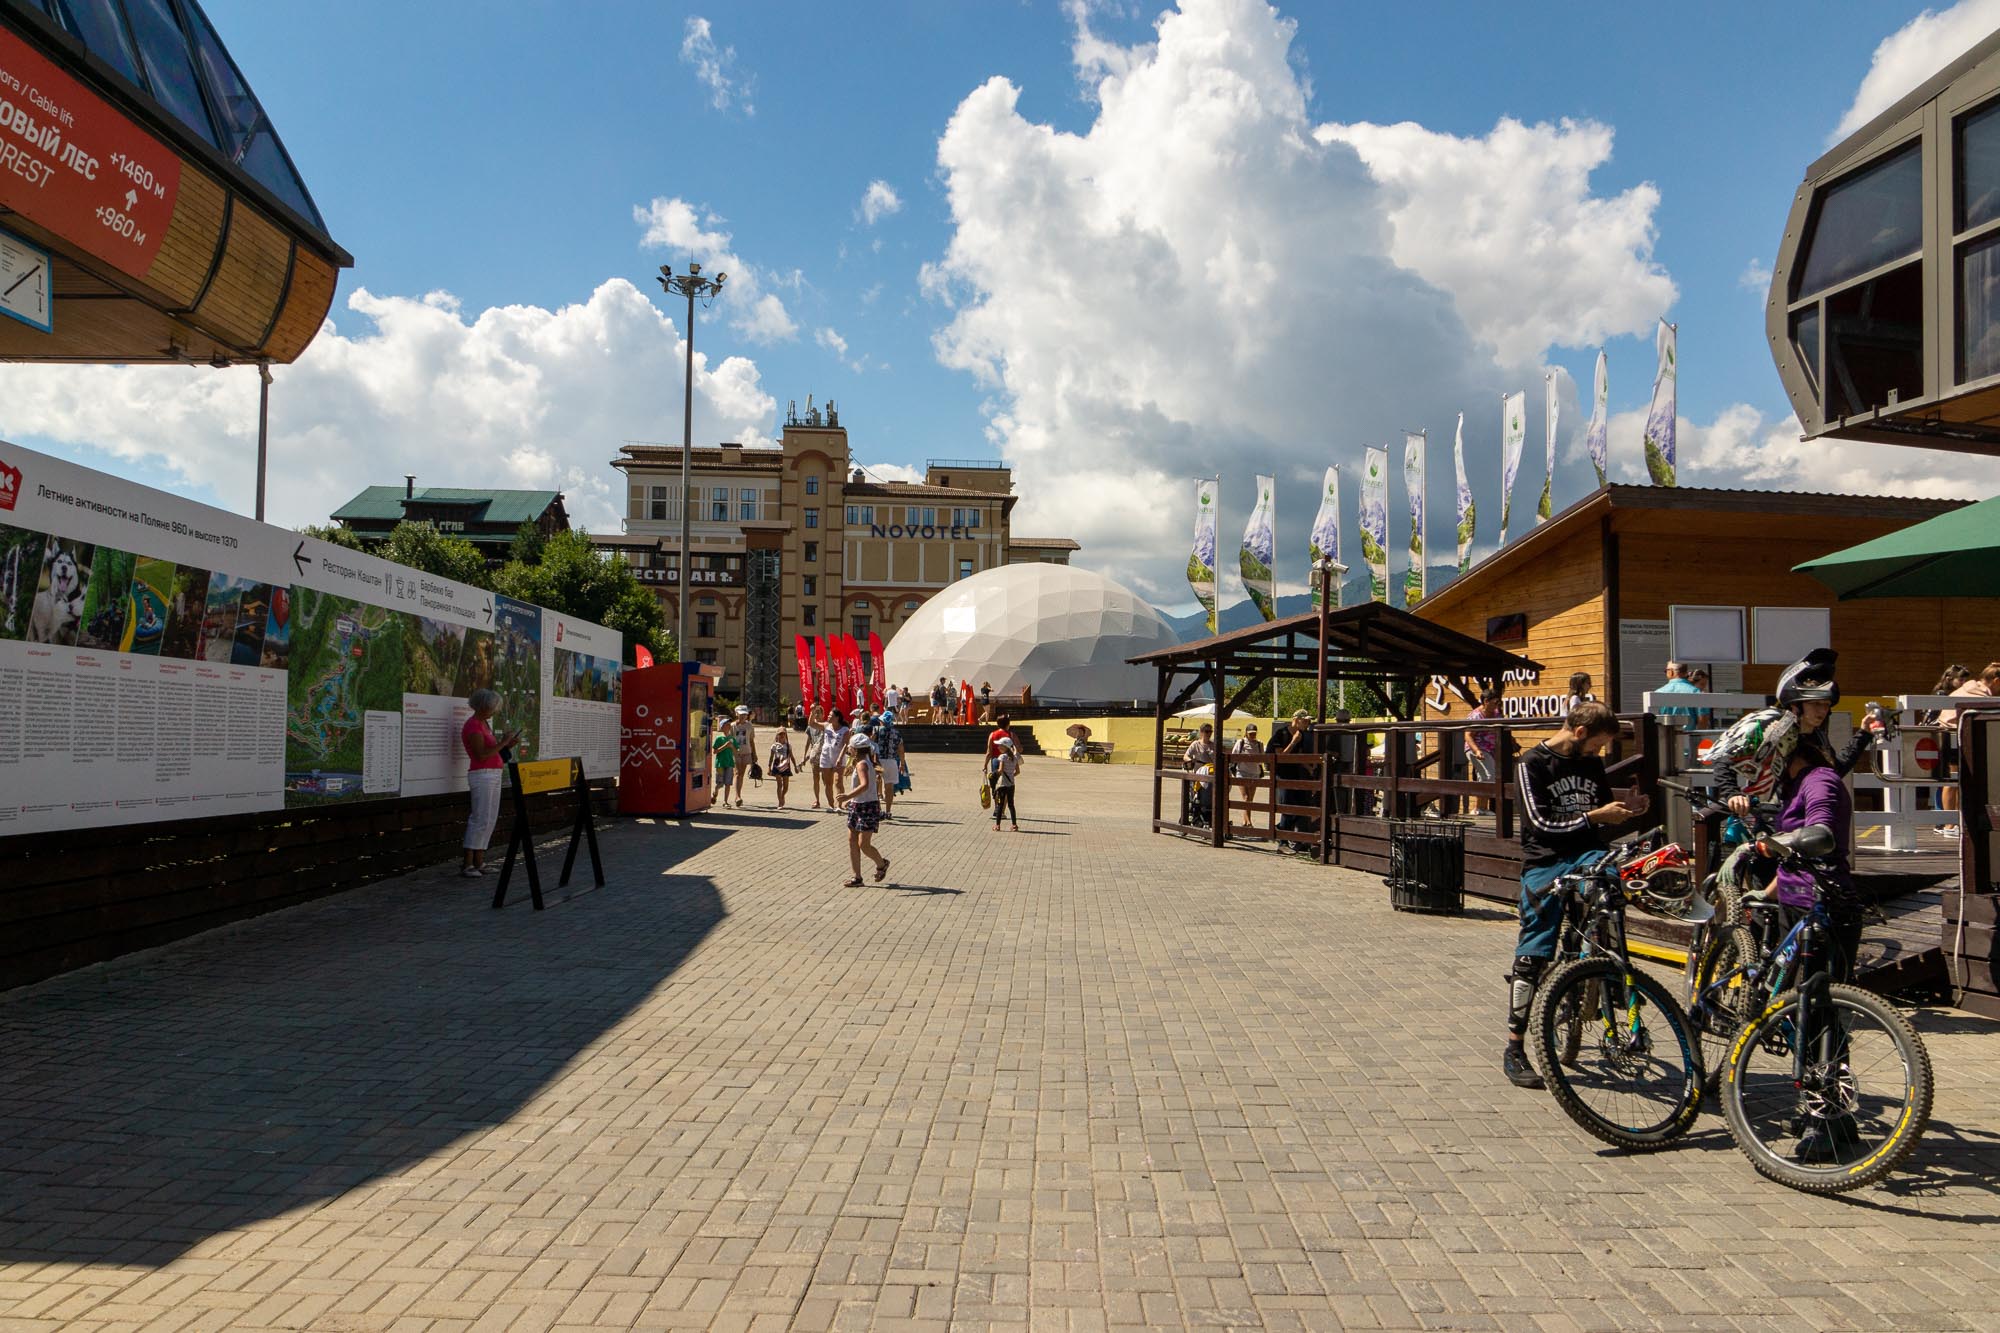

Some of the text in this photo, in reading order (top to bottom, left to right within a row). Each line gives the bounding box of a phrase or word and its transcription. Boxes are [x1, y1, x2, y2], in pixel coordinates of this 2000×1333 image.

[0, 68, 20, 91] ога
[29, 88, 58, 118] Cable
[60, 108, 74, 128] lift
[0, 97, 99, 181] ОВЫЙ ЛЕС
[110, 152, 153, 190] +1460
[96, 206, 135, 237] +960
[37, 484, 238, 549] Летние активности на Поляне 960 и высоте 1370
[871, 524, 975, 540] NOVOTEL
[323, 558, 382, 587] Ресторан Каштан
[623, 569, 716, 582] РЕСТОАН
